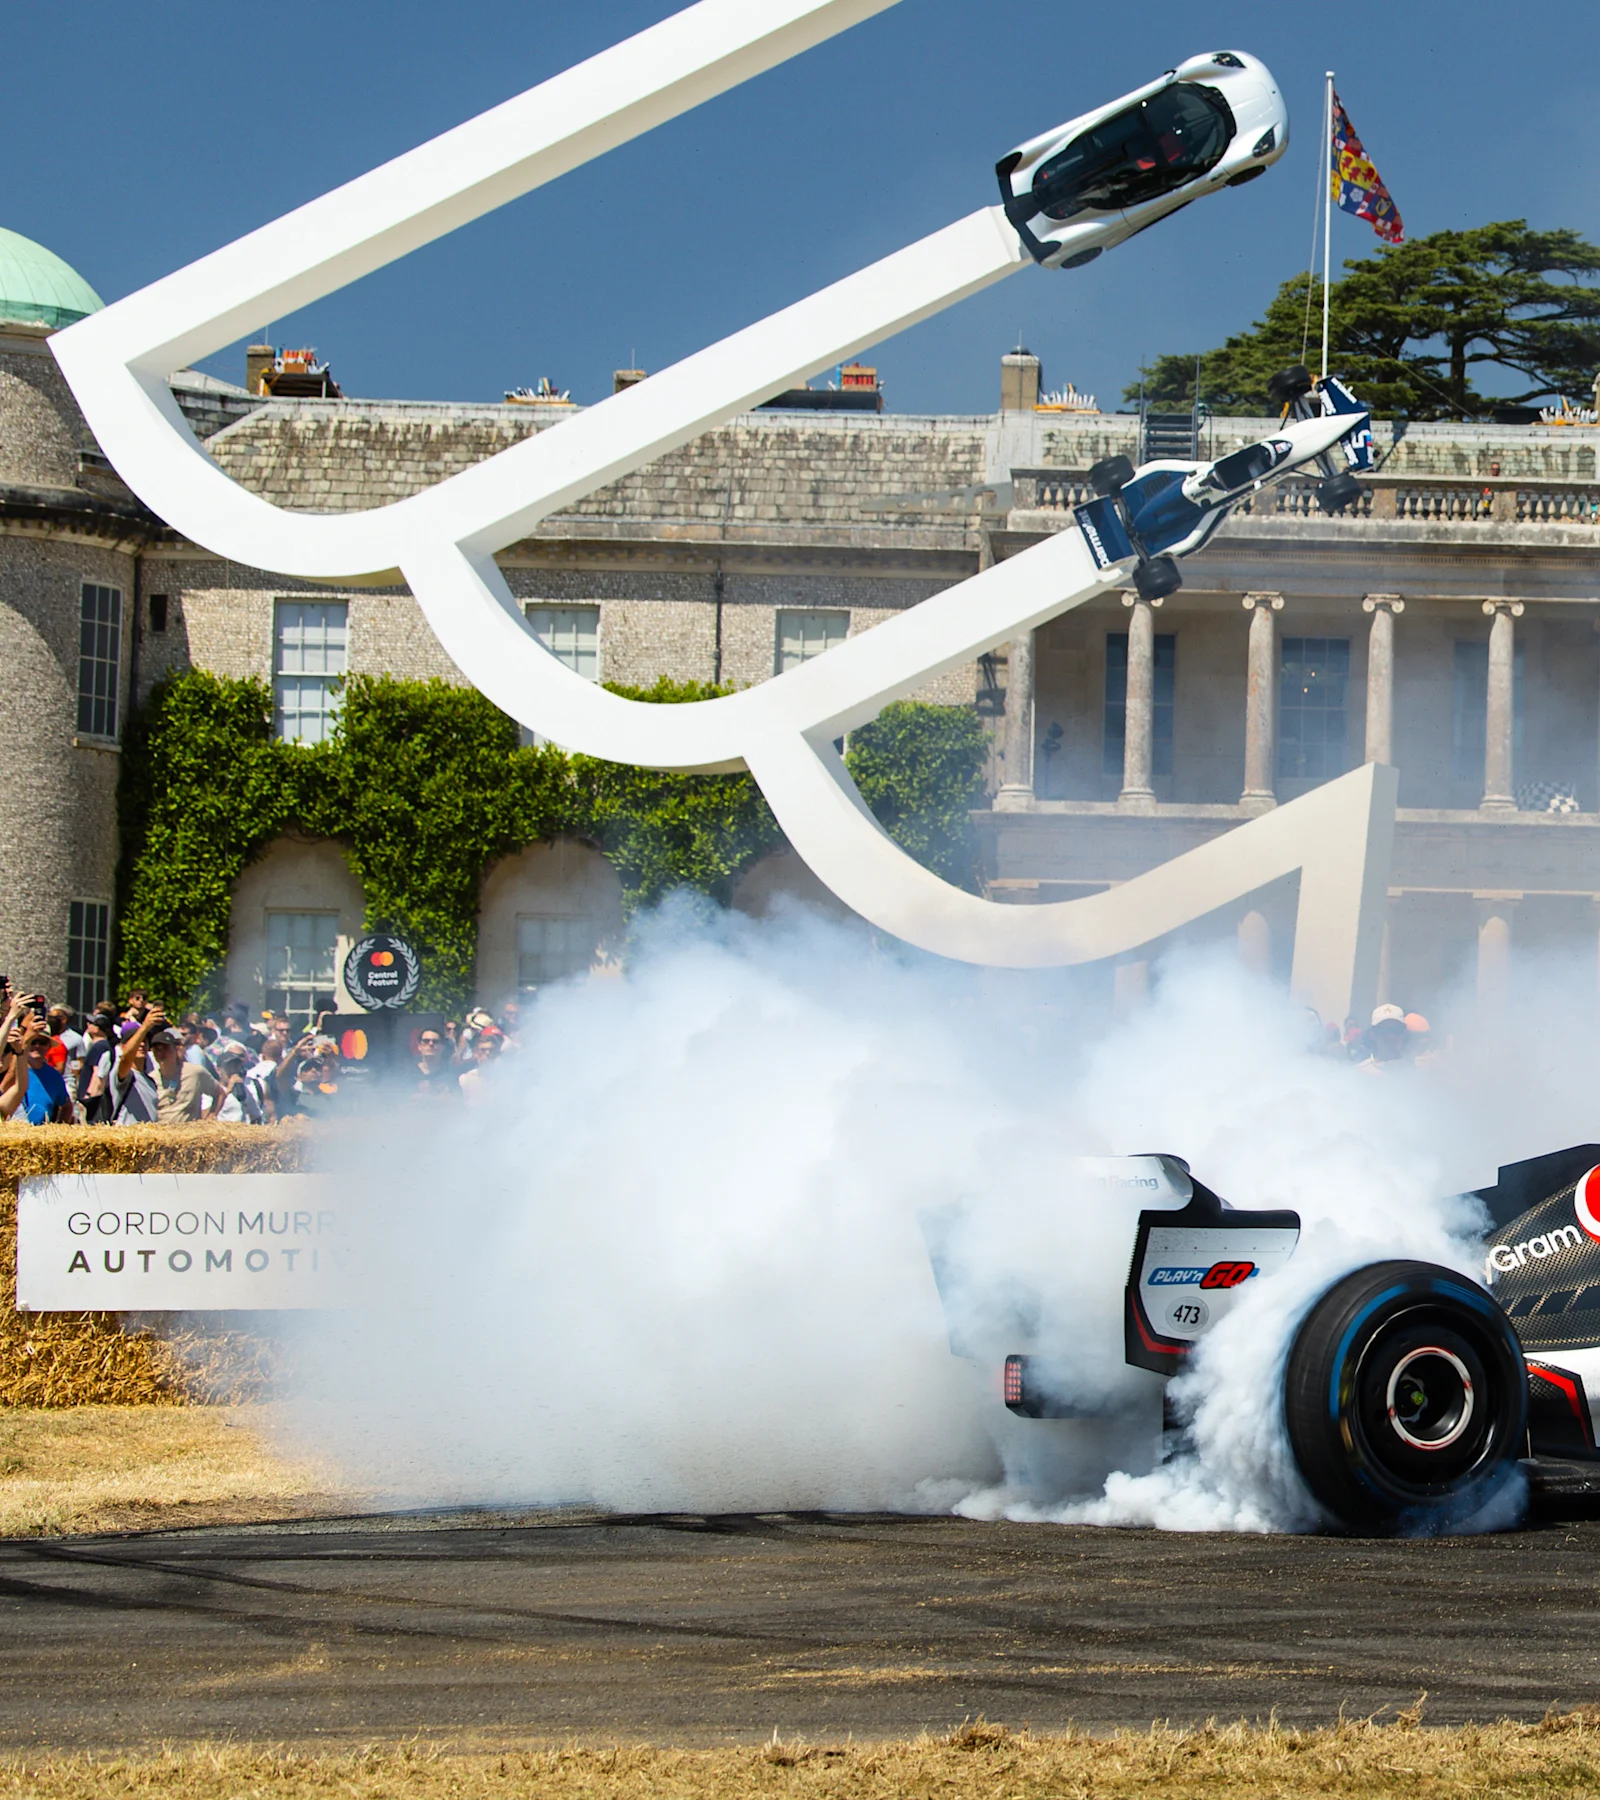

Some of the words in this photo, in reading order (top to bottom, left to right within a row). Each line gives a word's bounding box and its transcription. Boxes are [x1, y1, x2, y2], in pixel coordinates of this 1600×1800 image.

[368, 970, 398, 979] Central
[368, 978, 398, 986] Feature
[68, 1211, 225, 1235] GORDON
[1173, 1305, 1200, 1324] 473
